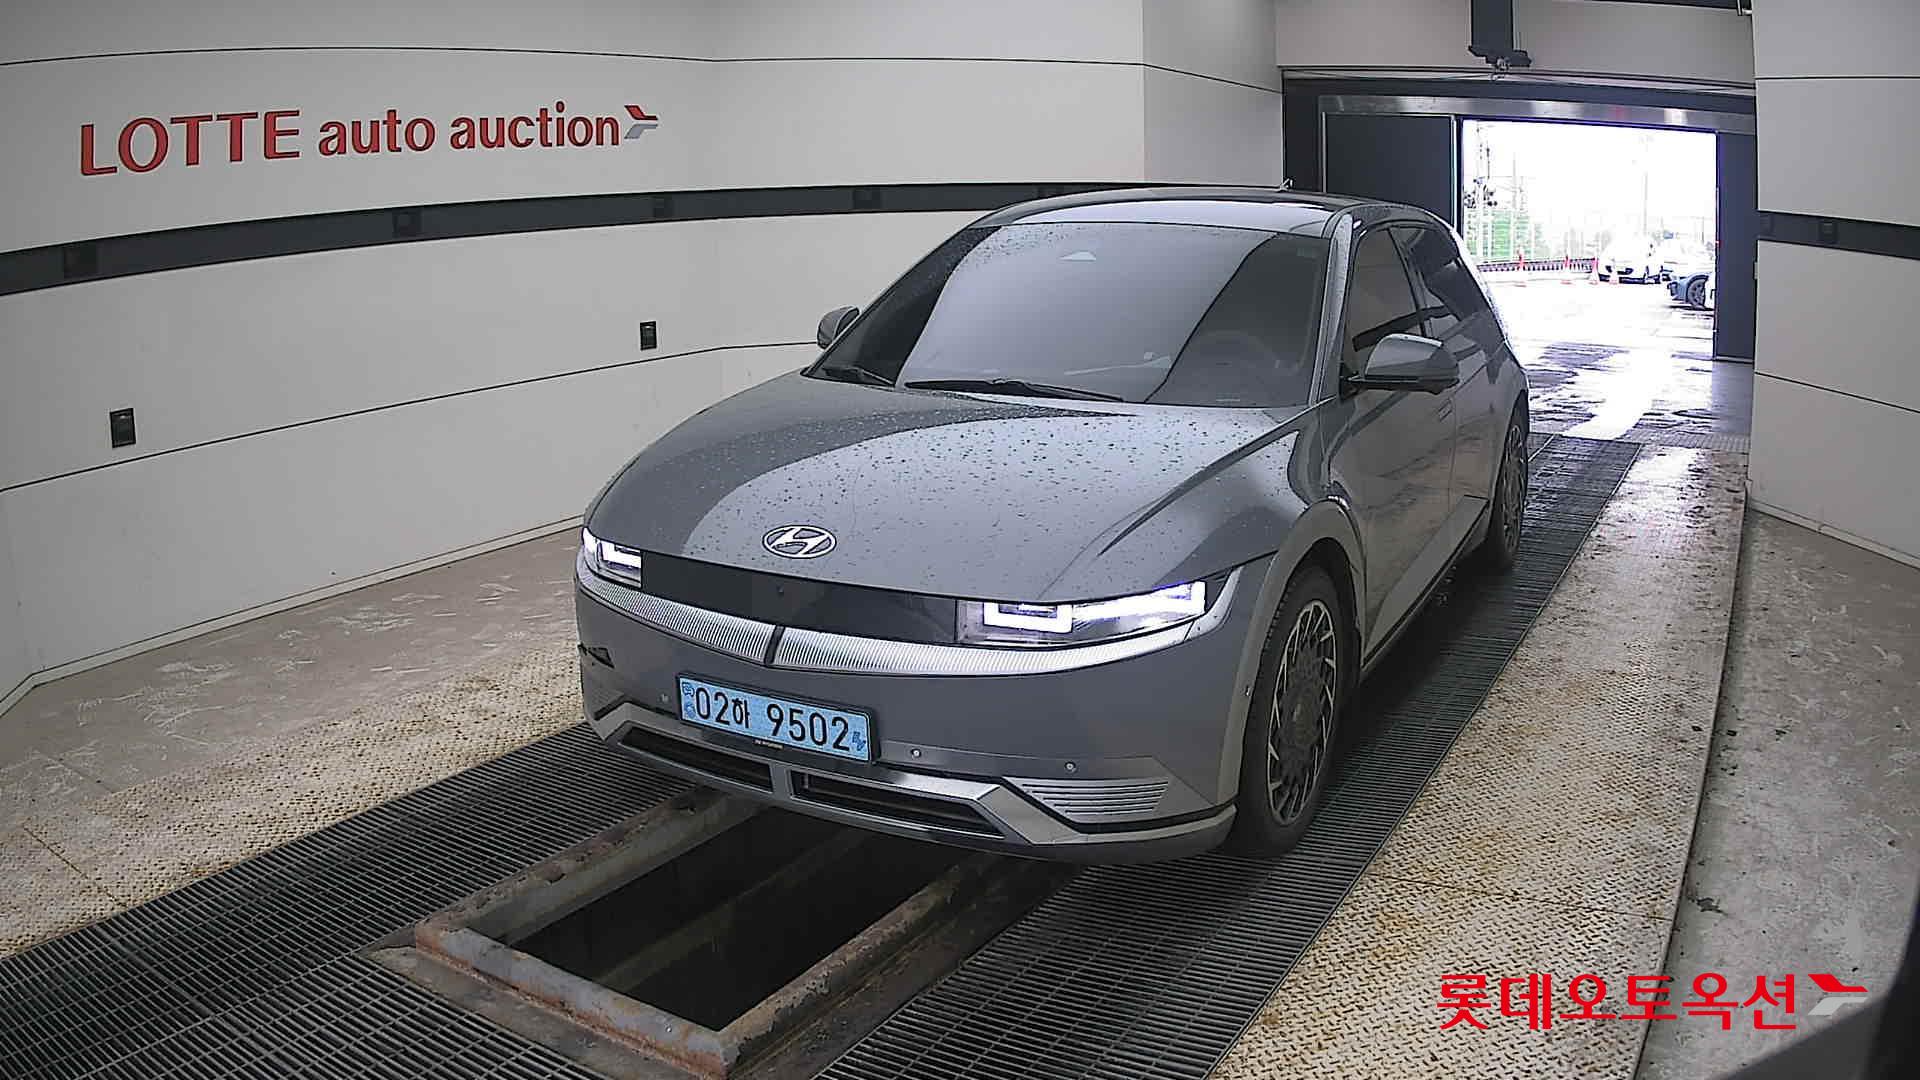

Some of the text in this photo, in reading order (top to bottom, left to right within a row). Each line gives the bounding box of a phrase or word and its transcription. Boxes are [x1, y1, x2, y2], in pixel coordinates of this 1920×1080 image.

[80, 101, 621, 176] LOTTE auto auction
[695, 687, 750, 728] 02하
[766, 703, 850, 750] 9502
